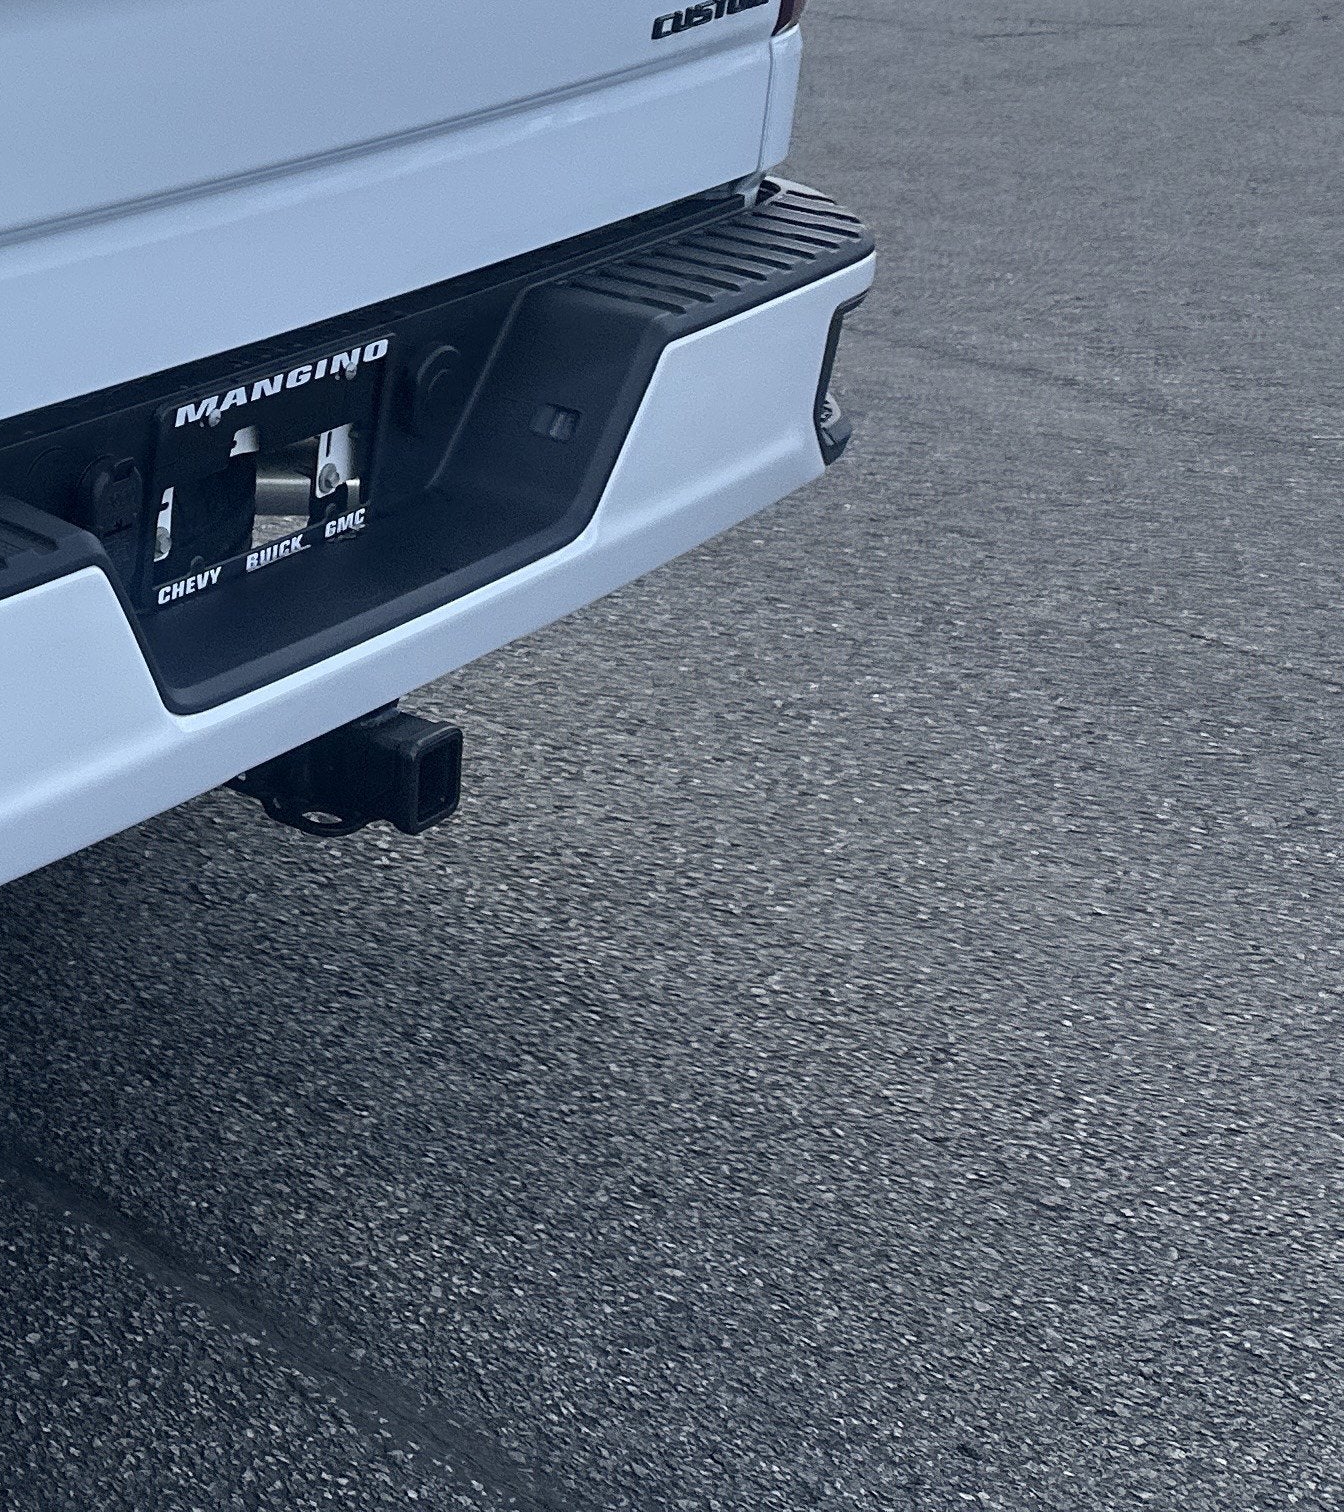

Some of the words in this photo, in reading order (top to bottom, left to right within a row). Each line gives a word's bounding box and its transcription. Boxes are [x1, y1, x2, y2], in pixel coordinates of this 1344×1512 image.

[174, 338, 390, 428] MANGINO
[157, 566, 222, 605] CHEVY
[245, 533, 304, 572] BUICK
[324, 507, 366, 539] GMC
